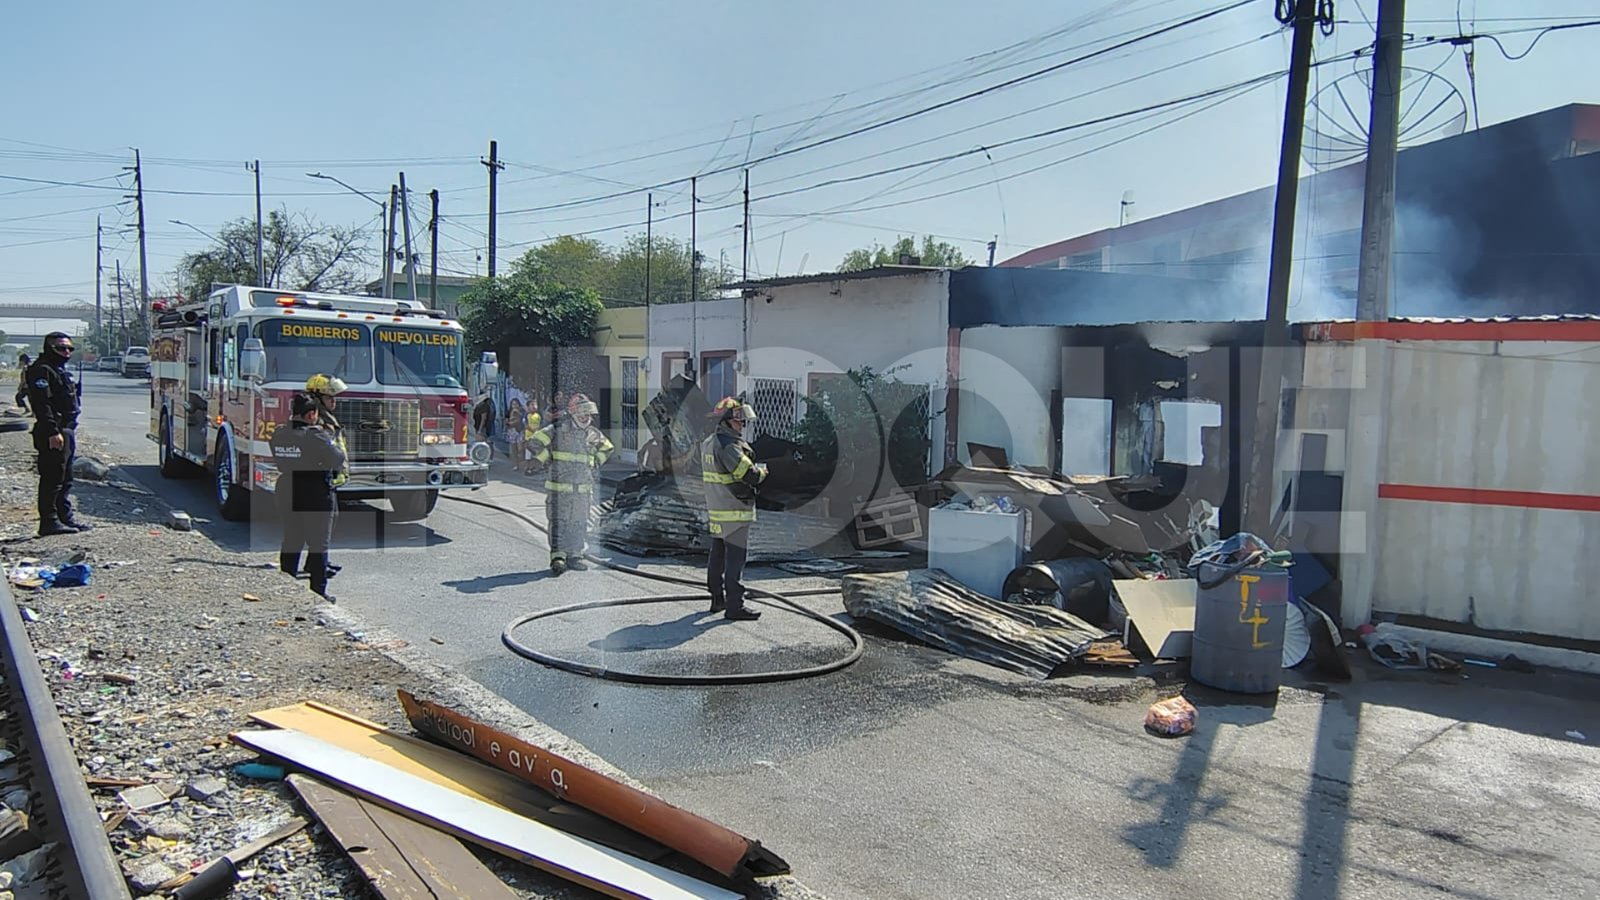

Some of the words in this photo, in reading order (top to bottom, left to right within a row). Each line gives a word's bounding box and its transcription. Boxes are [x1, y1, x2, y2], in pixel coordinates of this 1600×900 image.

[282, 324, 360, 341] BOMBEROS
[379, 330, 423, 344] NUEVO
[425, 335, 457, 347] LEON
[258, 420, 276, 440] 25
